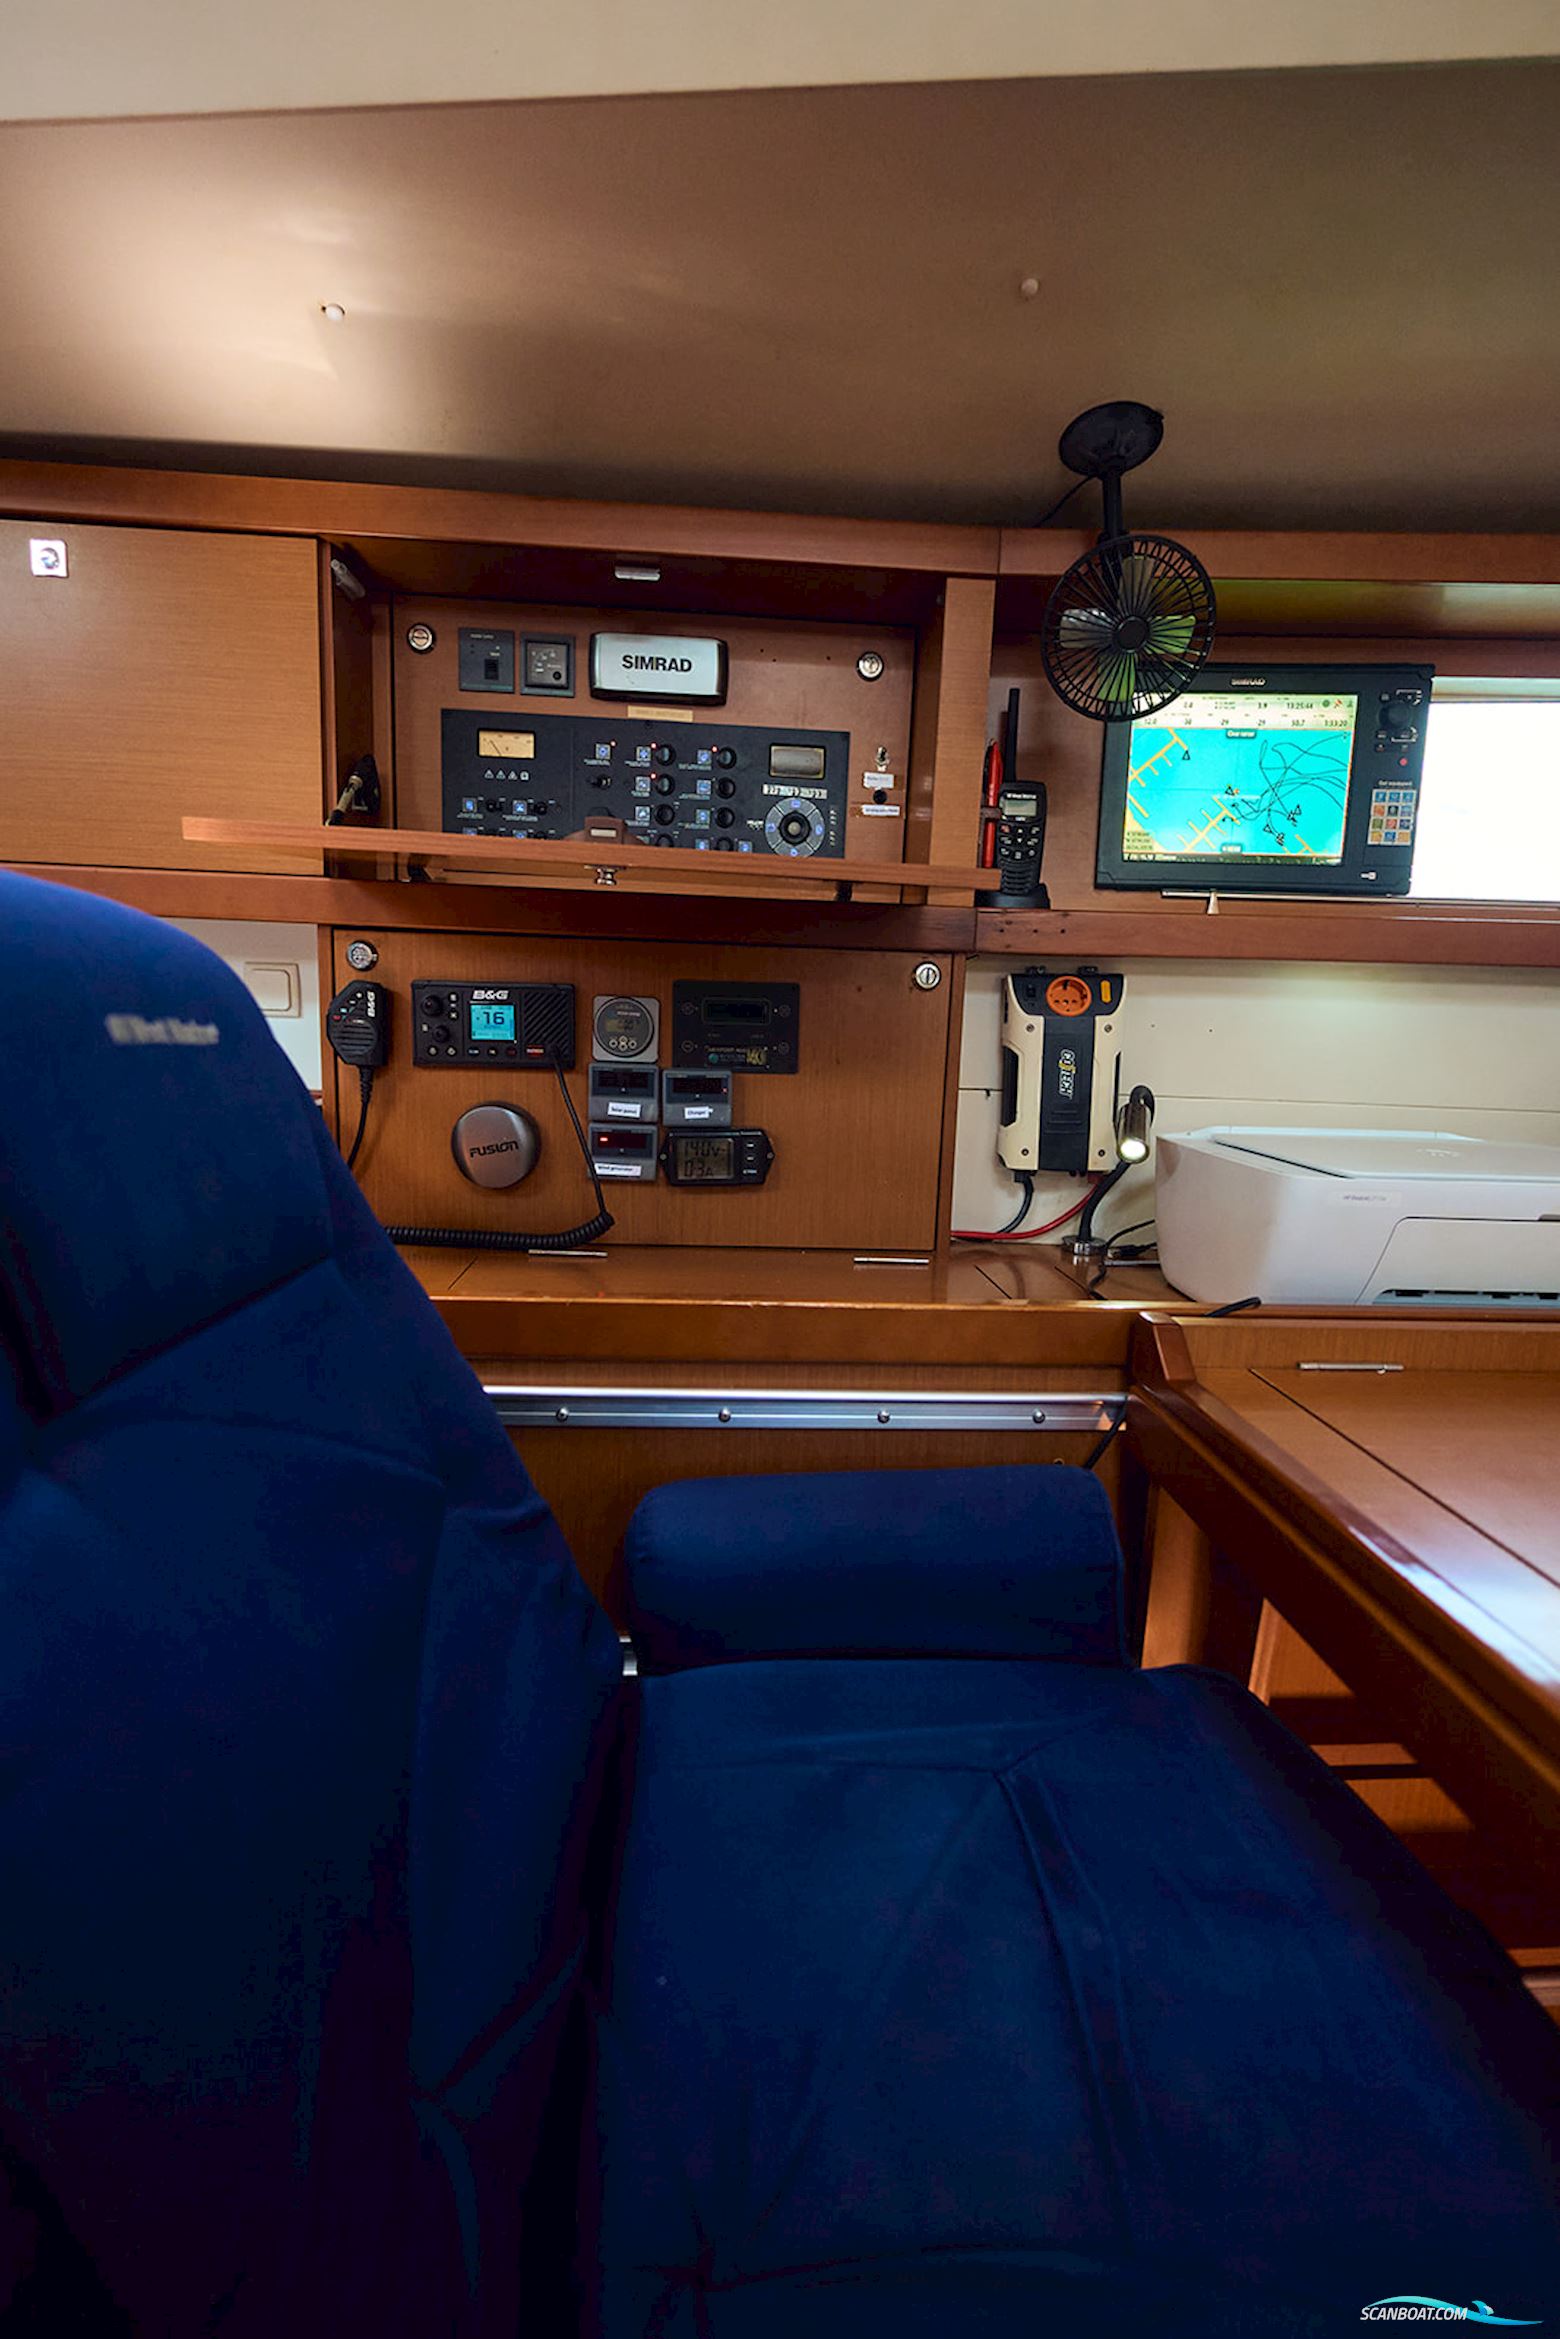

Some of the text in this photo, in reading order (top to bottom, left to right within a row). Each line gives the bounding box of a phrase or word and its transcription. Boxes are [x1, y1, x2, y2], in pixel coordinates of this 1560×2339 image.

[622, 655, 692, 673] SIMRAD
[367, 991, 376, 1017] B&G
[472, 990, 509, 1000] B&G
[483, 1011, 504, 1025] 16
[469, 1140, 519, 1158] FUSION
